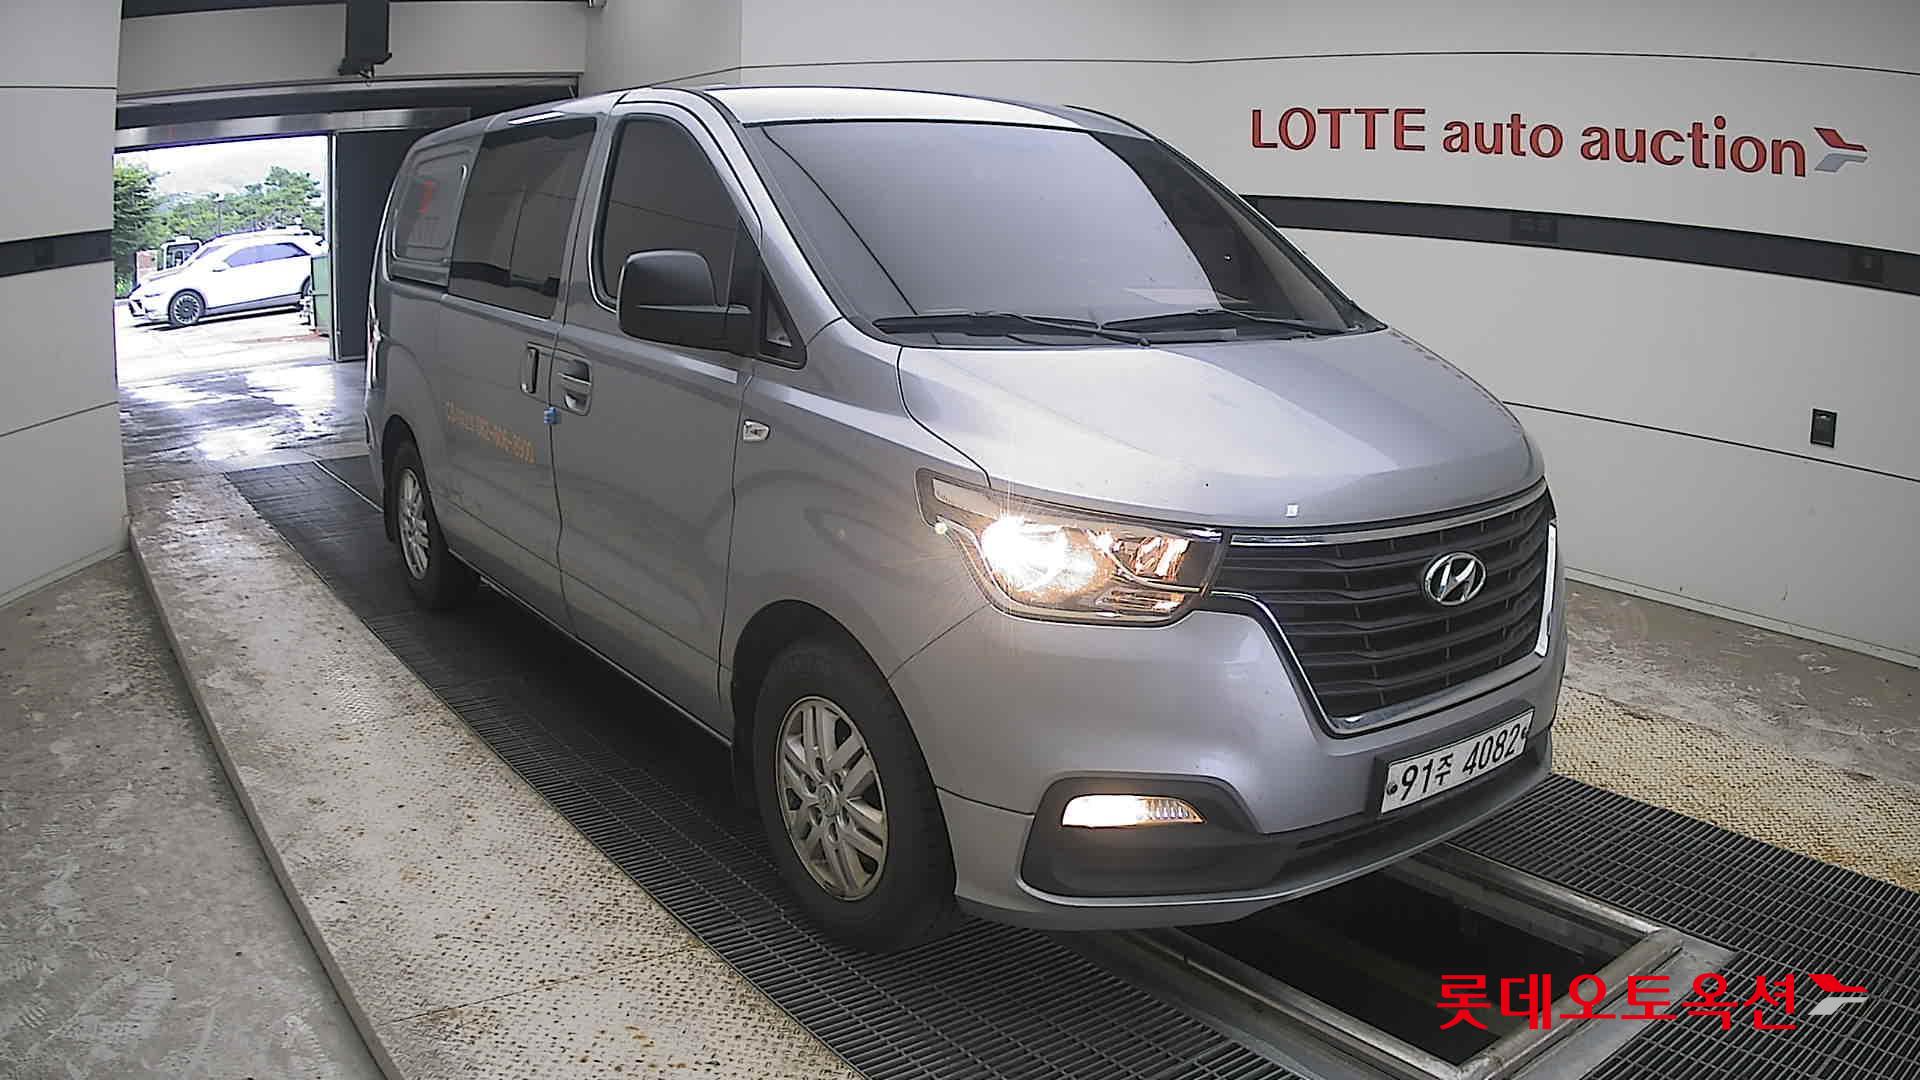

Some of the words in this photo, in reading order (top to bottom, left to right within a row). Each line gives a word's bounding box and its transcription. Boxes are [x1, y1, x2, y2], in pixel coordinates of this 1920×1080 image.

[1250, 107, 1426, 152] LOTTE
[1442, 113, 1563, 158] auto
[1580, 116, 1807, 178] auction
[1462, 723, 1521, 776] 4082
